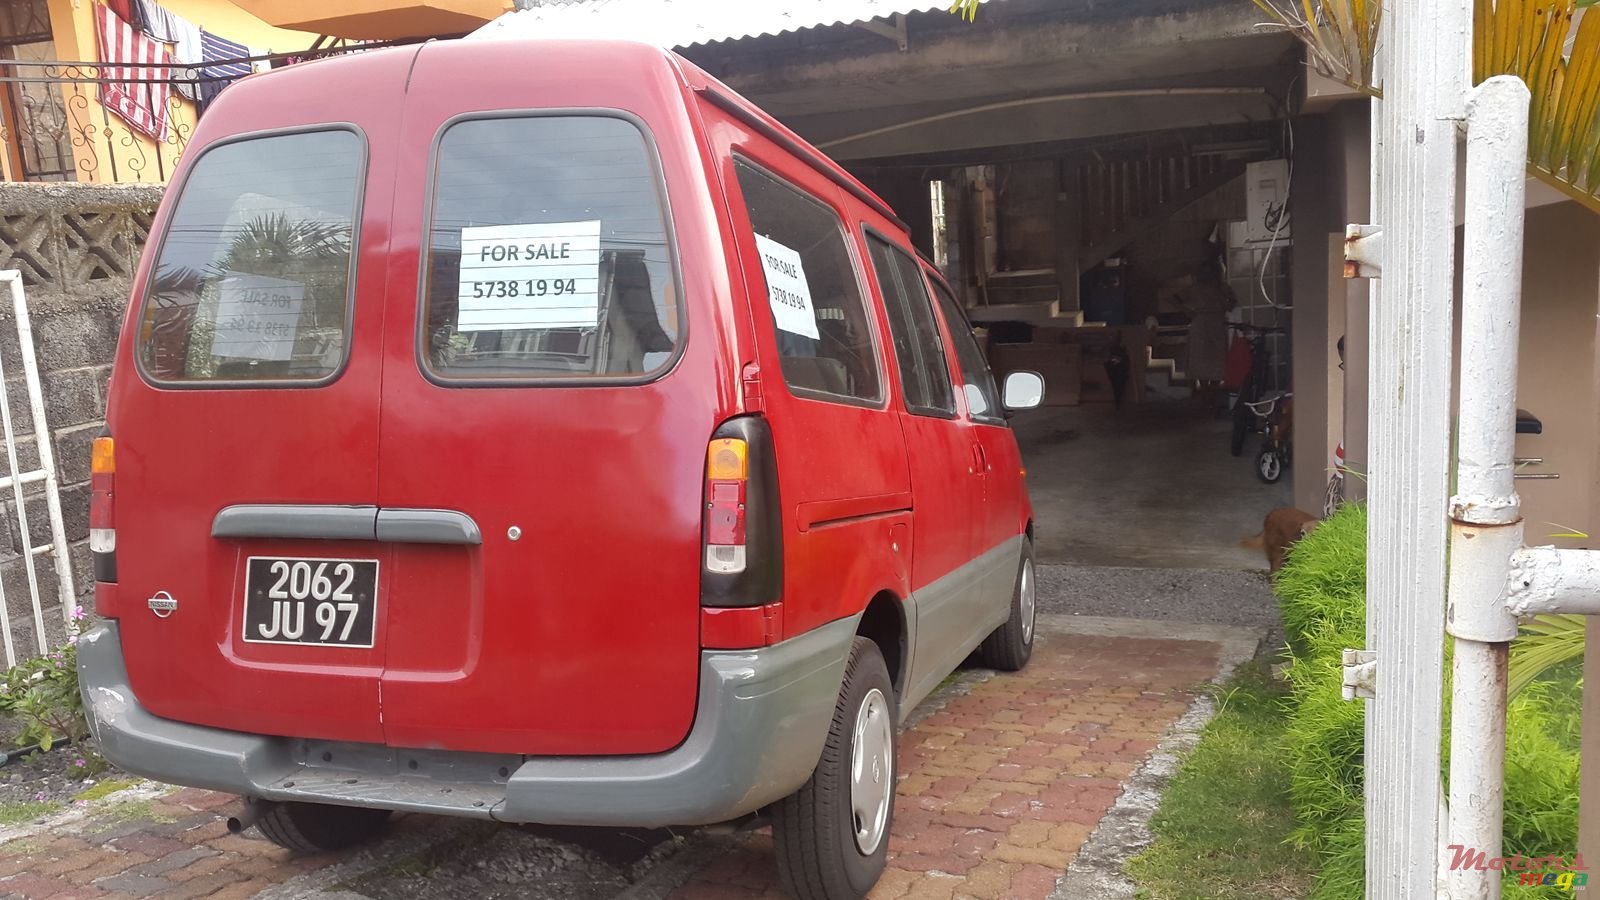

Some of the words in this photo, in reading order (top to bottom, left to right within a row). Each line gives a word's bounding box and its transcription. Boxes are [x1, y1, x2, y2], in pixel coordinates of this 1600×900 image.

[481, 245, 519, 262] FOR
[524, 242, 570, 260] SALE
[765, 253, 782, 272] FOR
[779, 260, 798, 279] SALE
[472, 280, 519, 299] 5738
[525, 279, 548, 297] 19
[553, 278, 576, 296] 94
[771, 285, 788, 305] 5738
[787, 292, 797, 308] 19
[796, 295, 807, 311] 94
[268, 560, 355, 601] 2062
[150, 600, 175, 609] NISSAN
[258, 601, 305, 640] JU
[315, 602, 359, 641] 97
